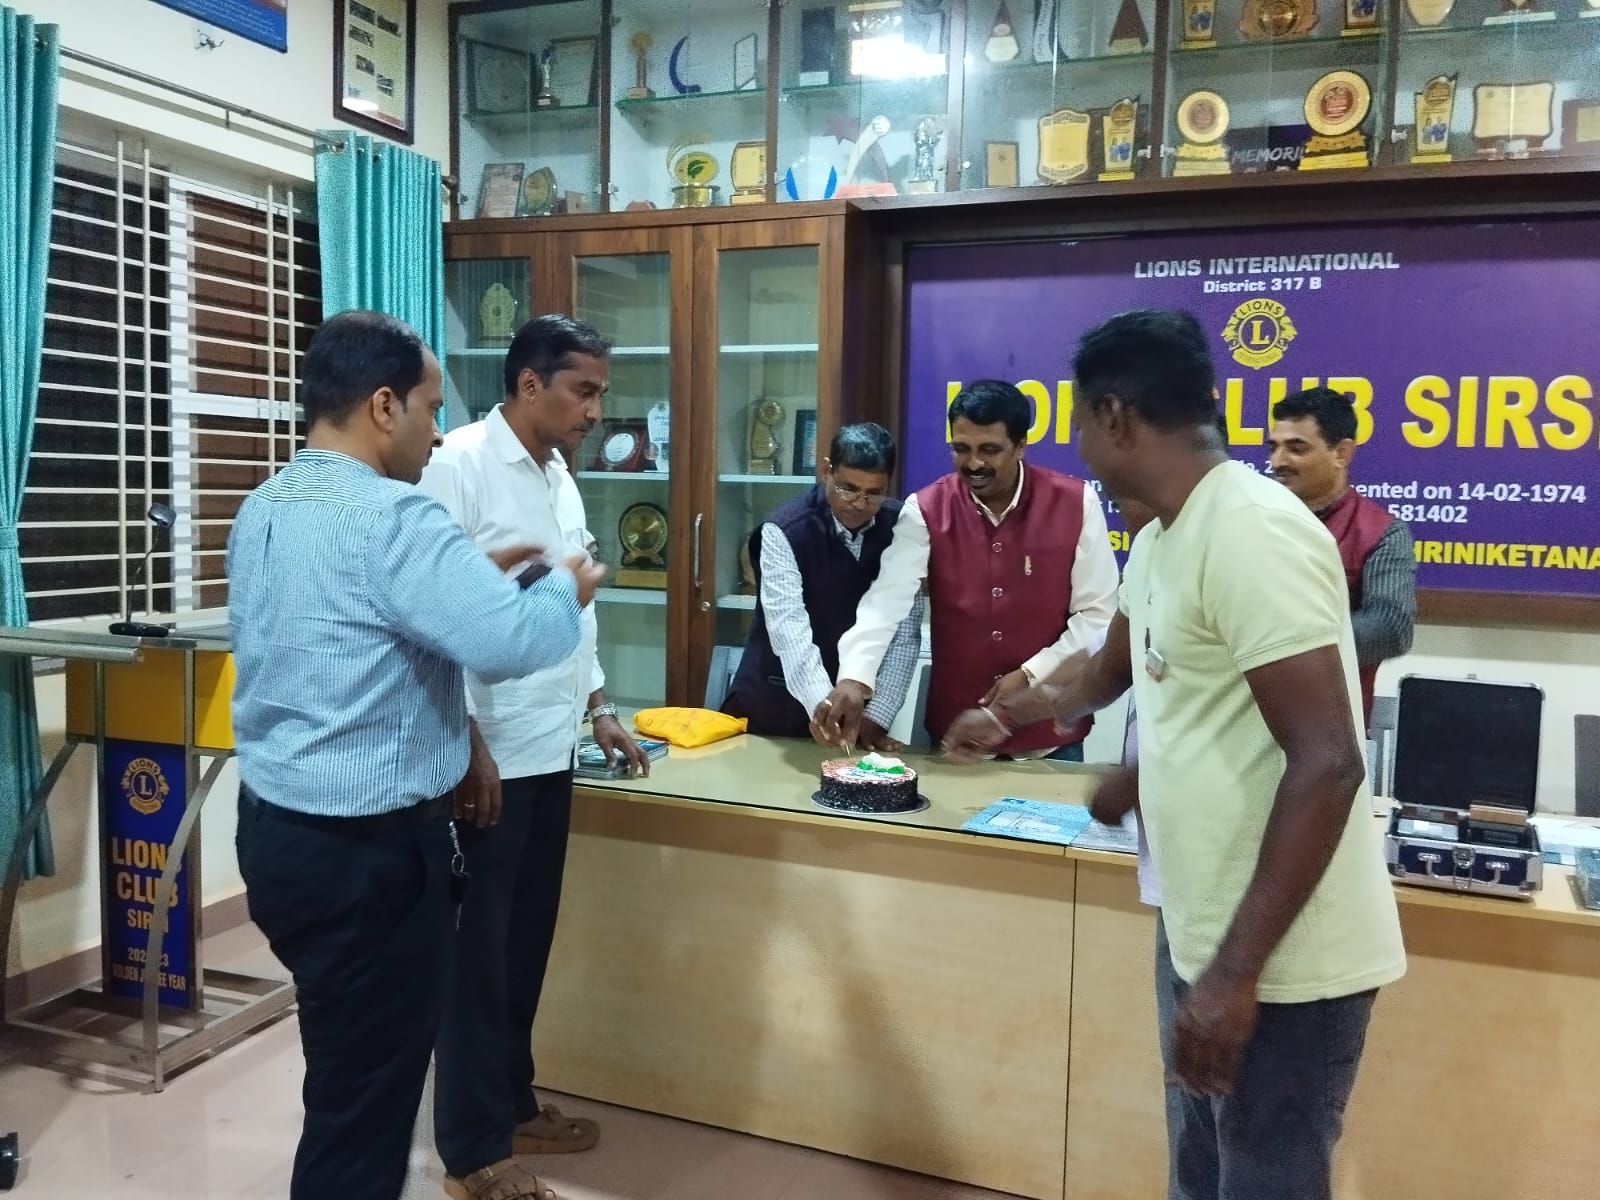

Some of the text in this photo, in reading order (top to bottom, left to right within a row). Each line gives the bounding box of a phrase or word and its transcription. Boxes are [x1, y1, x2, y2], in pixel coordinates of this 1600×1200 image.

[1134, 252, 1400, 278] LIONS INTERNATIONAL
[1203, 276, 1322, 293] District 317 B
[1239, 301, 1282, 315] LIONS
[1250, 320, 1270, 345] L
[1401, 374, 1600, 451] SIRS
[1348, 480, 1587, 504] ented on 14-02-1974
[1388, 503, 1468, 523] 581402
[112, 836, 182, 873] LION
